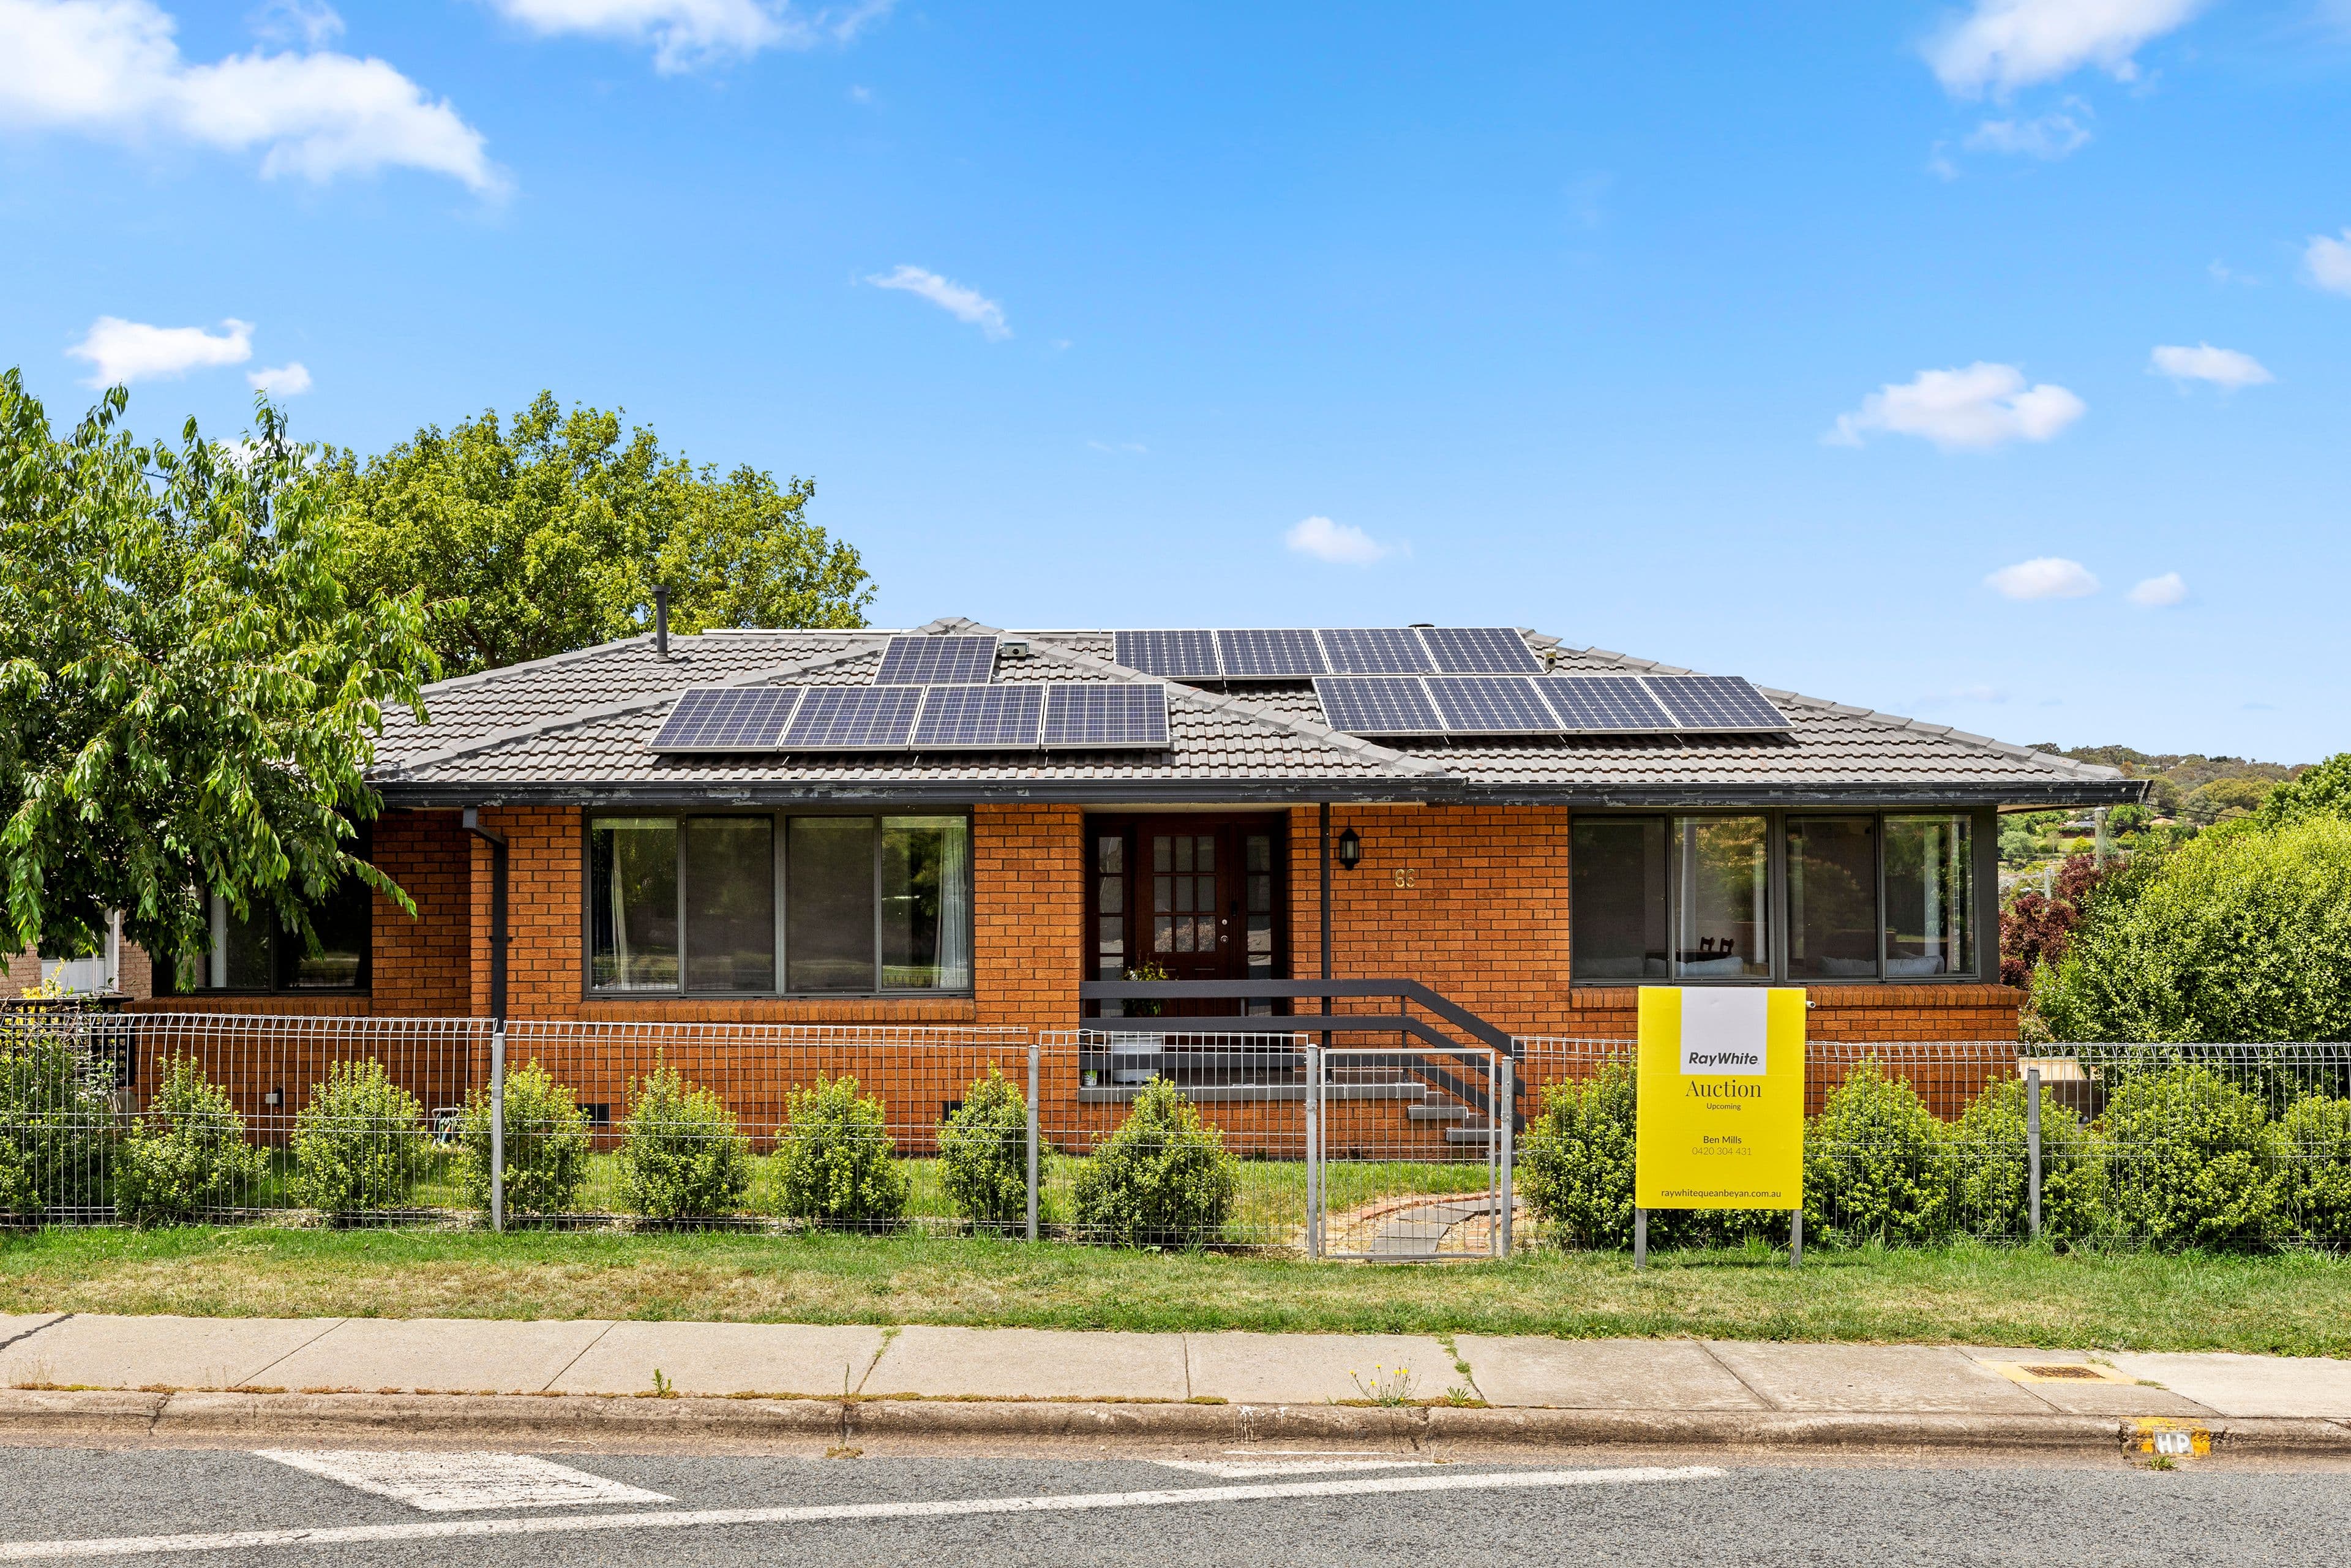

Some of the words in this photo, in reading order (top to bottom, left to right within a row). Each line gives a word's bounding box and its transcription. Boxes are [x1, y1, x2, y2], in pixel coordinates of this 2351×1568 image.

[1395, 868, 1415, 888] 66
[1685, 1079, 1761, 1098] Auction
[1706, 1103, 1741, 1111] Upcoming
[1692, 1147, 1714, 1155] 0420
[1736, 1147, 1752, 1156] 431
[1661, 1188, 1781, 1199] raywhitequeanbeyan.com.au
[2157, 1433, 2190, 1454] HP
